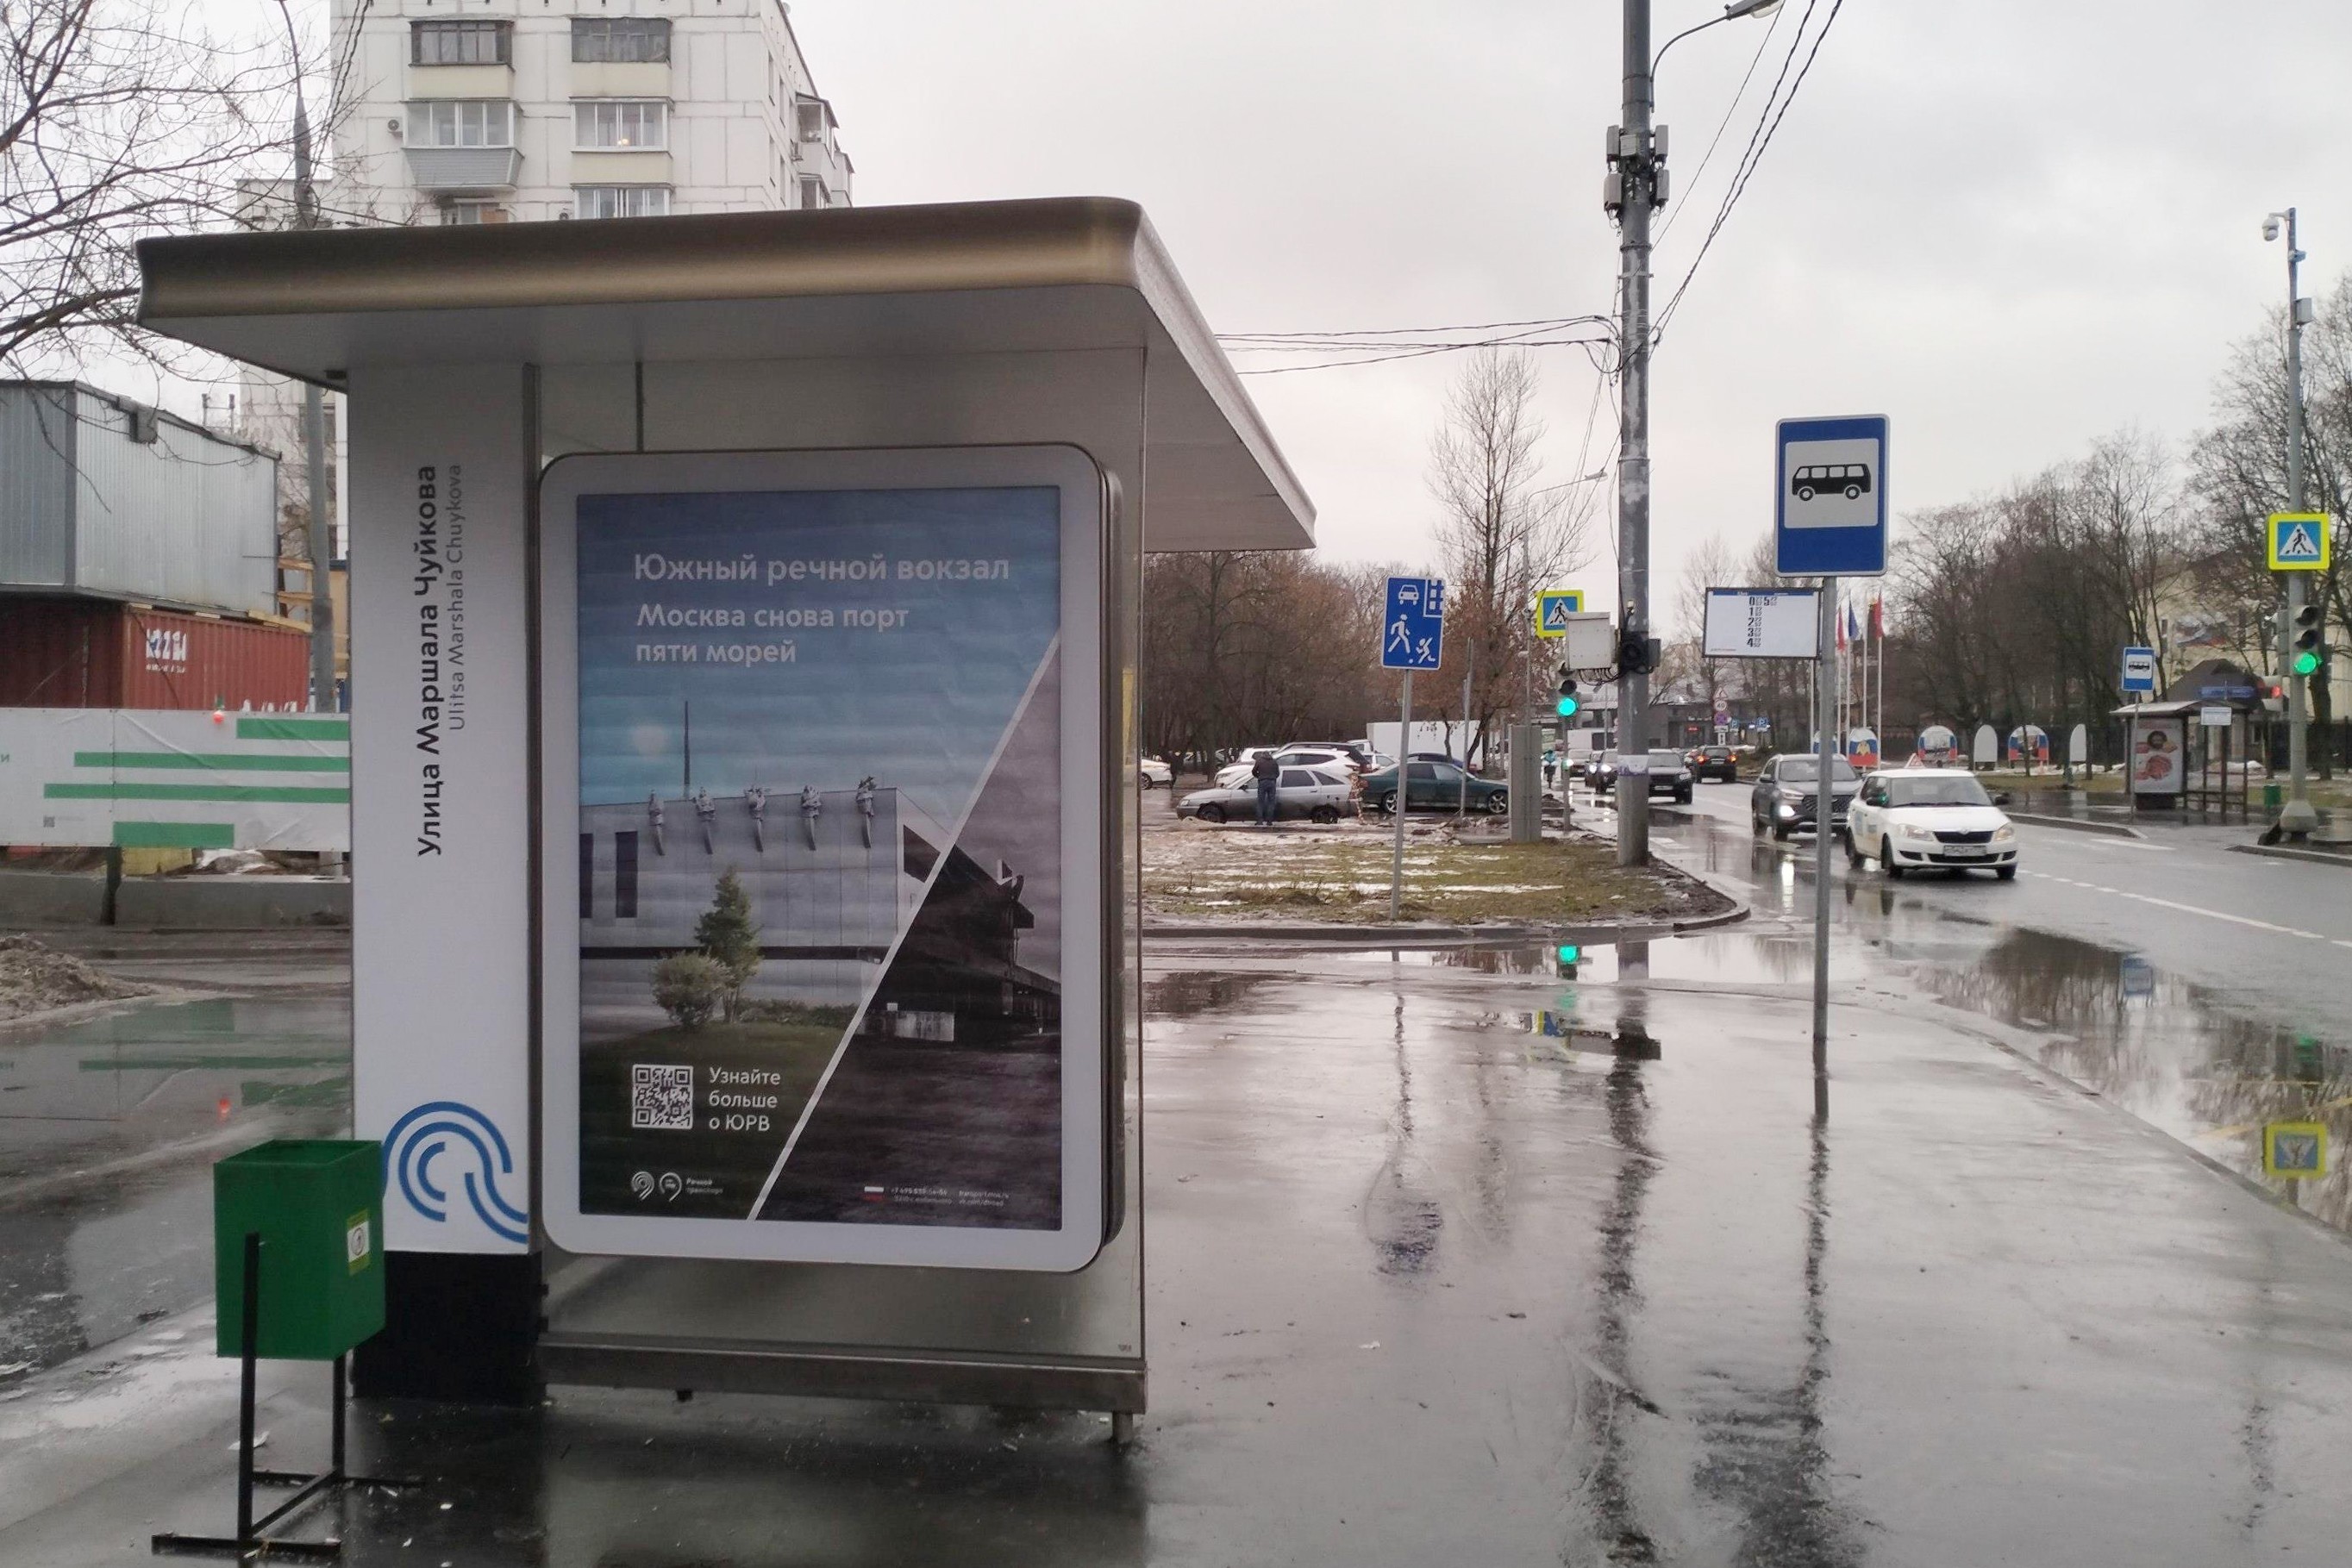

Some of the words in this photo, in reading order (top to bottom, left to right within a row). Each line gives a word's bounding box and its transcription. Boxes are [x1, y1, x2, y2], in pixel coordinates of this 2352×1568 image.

[446, 464, 466, 564] Chuykova
[414, 465, 443, 596] Чуйкова
[635, 553, 757, 580] Южный
[767, 553, 887, 586] речной
[898, 559, 1010, 580] вокзал
[1749, 597, 1755, 606] 0
[1763, 597, 1770, 606] 5
[446, 569, 465, 665] Marshala
[636, 603, 746, 627] Москва
[754, 609, 835, 627] снова
[842, 609, 909, 633] порт
[1748, 617, 1755, 627] 2
[1747, 638, 1753, 647] 4
[1748, 628, 1754, 637] 3
[635, 644, 697, 662] пяти
[704, 639, 797, 667] морей
[416, 603, 444, 755] Маршала
[448, 672, 466, 730] Ulitsa
[417, 763, 444, 857] Улица
[710, 1066, 781, 1085] Узнайте
[709, 1090, 778, 1109] больше
[709, 1117, 720, 1130] о
[725, 1114, 770, 1132] ЮРВ
